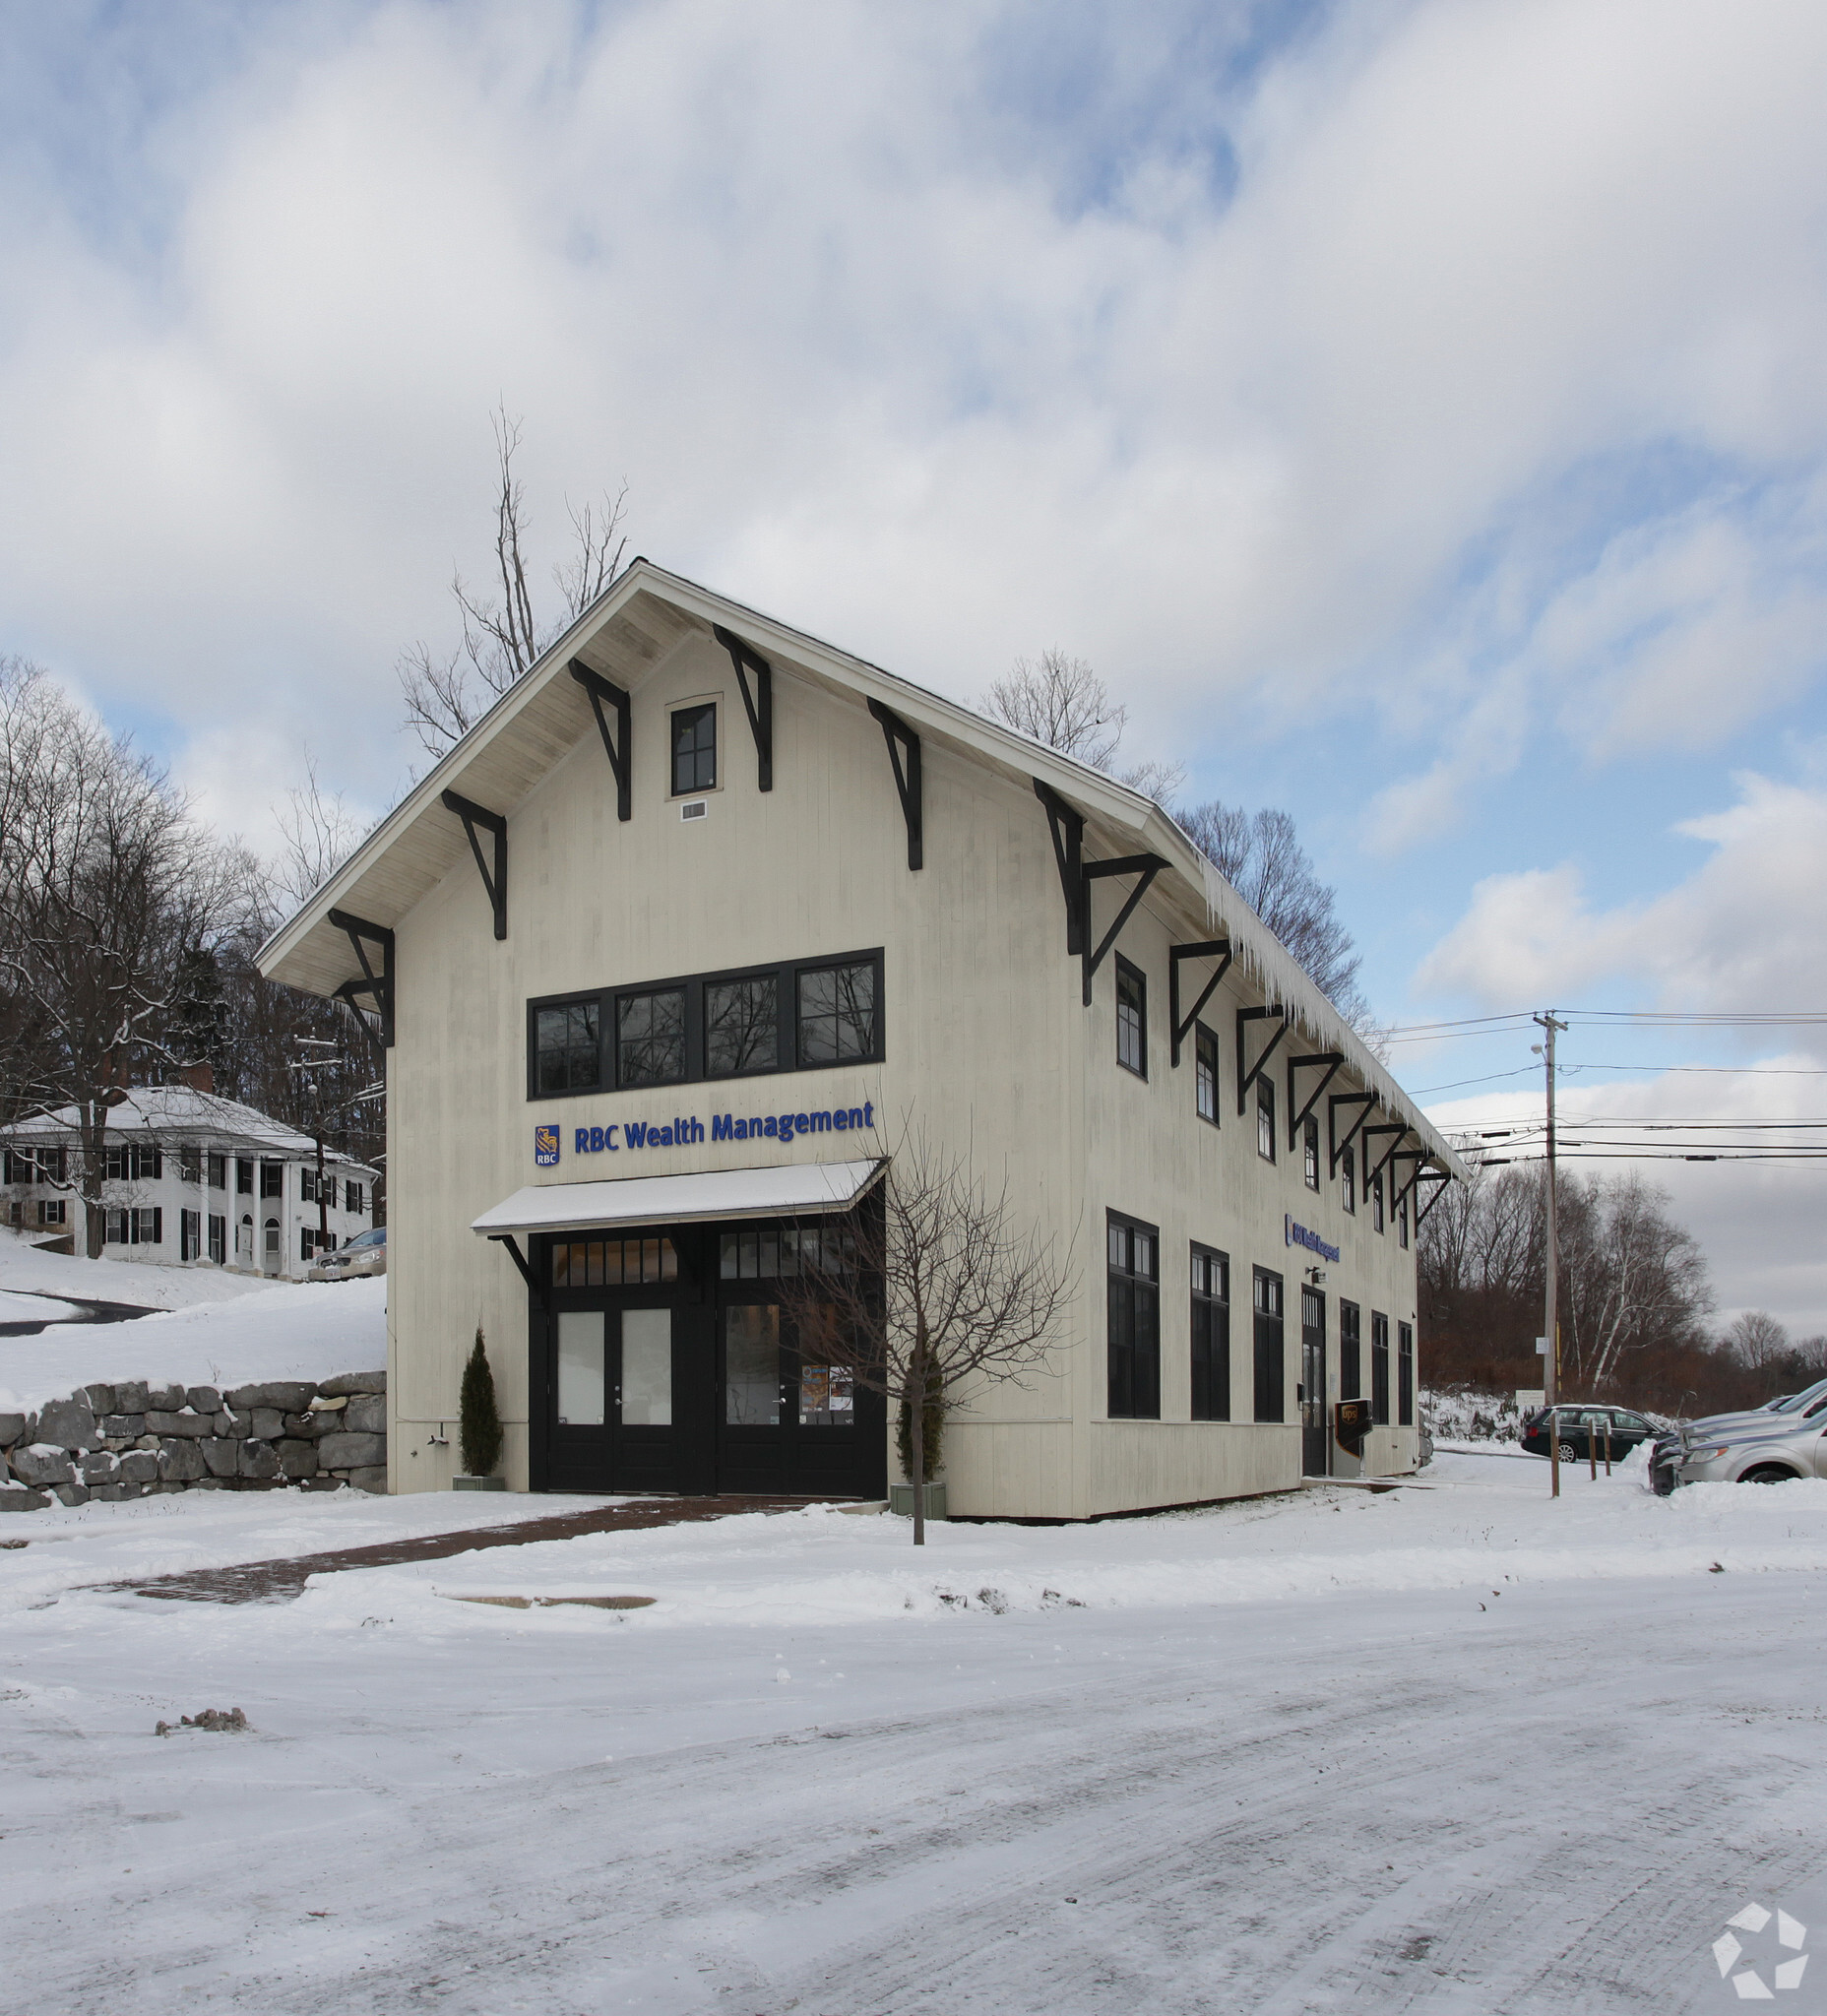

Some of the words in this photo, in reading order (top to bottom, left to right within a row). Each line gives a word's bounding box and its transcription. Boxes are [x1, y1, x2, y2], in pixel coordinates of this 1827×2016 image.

[575, 1125, 619, 1154] RBC
[623, 1116, 705, 1150] Wealth
[712, 1101, 874, 1142] Management
[536, 1154, 556, 1165] RBC
